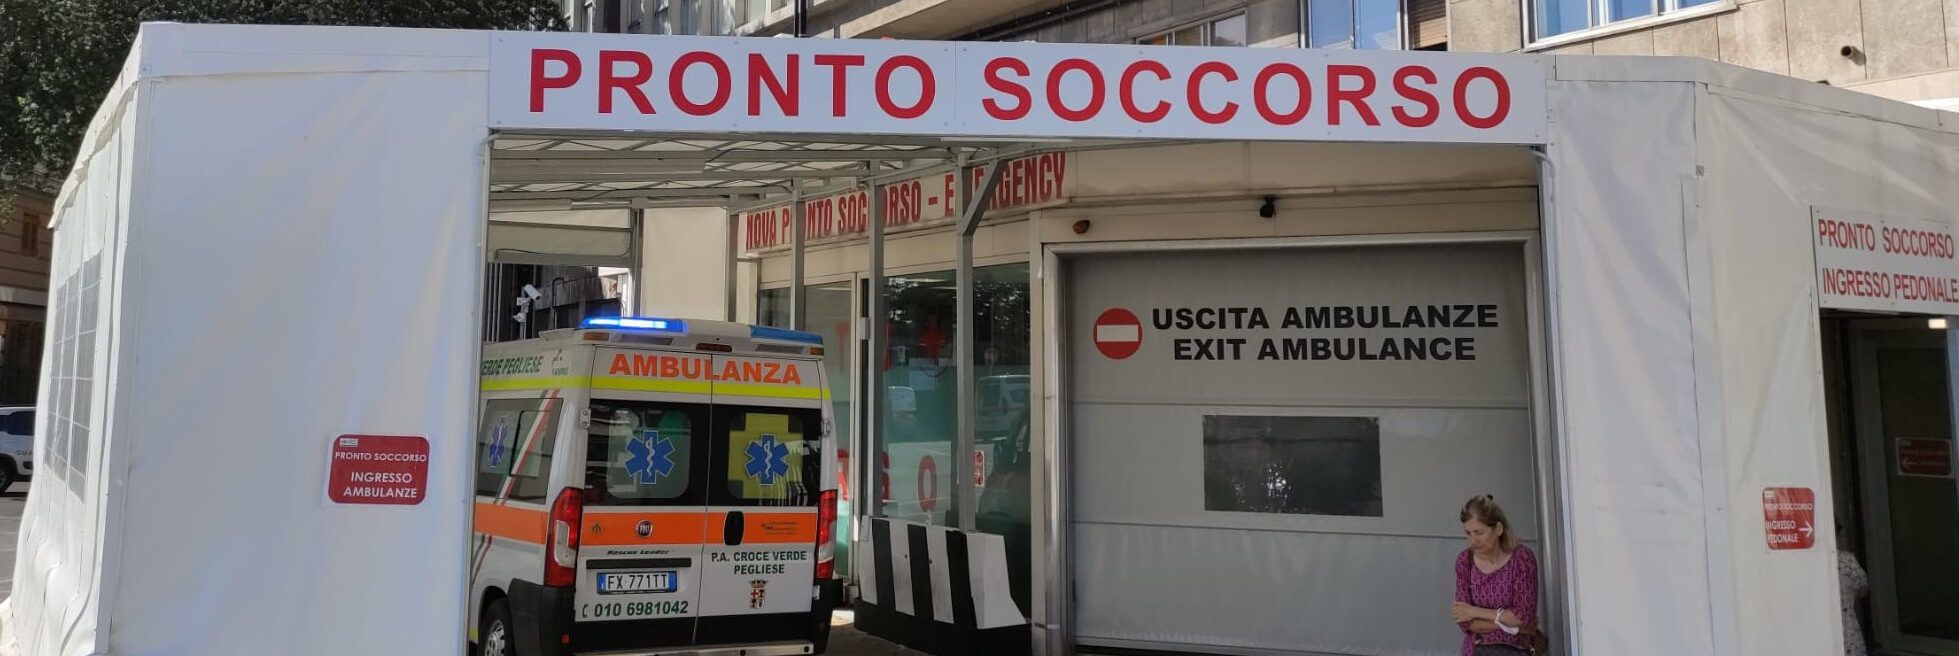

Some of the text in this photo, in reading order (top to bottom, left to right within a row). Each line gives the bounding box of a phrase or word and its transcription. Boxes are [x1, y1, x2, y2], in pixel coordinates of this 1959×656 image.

[529, 48, 1512, 129] PRONTO SOCCORSO
[745, 209, 777, 250] NOVA
[782, 198, 832, 245] PNTO
[838, 180, 922, 236] SOCRSO
[1818, 218, 1954, 259] PRONTO SOCCORSO
[1822, 267, 1959, 303] INGRESSO PEDONALE
[1152, 304, 1499, 331] USCITA AMBULANZE
[1173, 337, 1476, 361] EXIT AMBULANCE
[502, 356, 543, 374] PEGLIESE
[609, 353, 801, 385] AMBULANZA
[335, 451, 427, 462] PRONTO SOCCORSO
[351, 471, 413, 483] INGRESSO
[343, 486, 418, 498] AMBULANZE
[711, 550, 807, 562] P.A. CROCE VERDE
[734, 564, 785, 575] PEGLIESE
[607, 574, 667, 590] FX 771TT
[594, 600, 689, 618] 010 6981042
